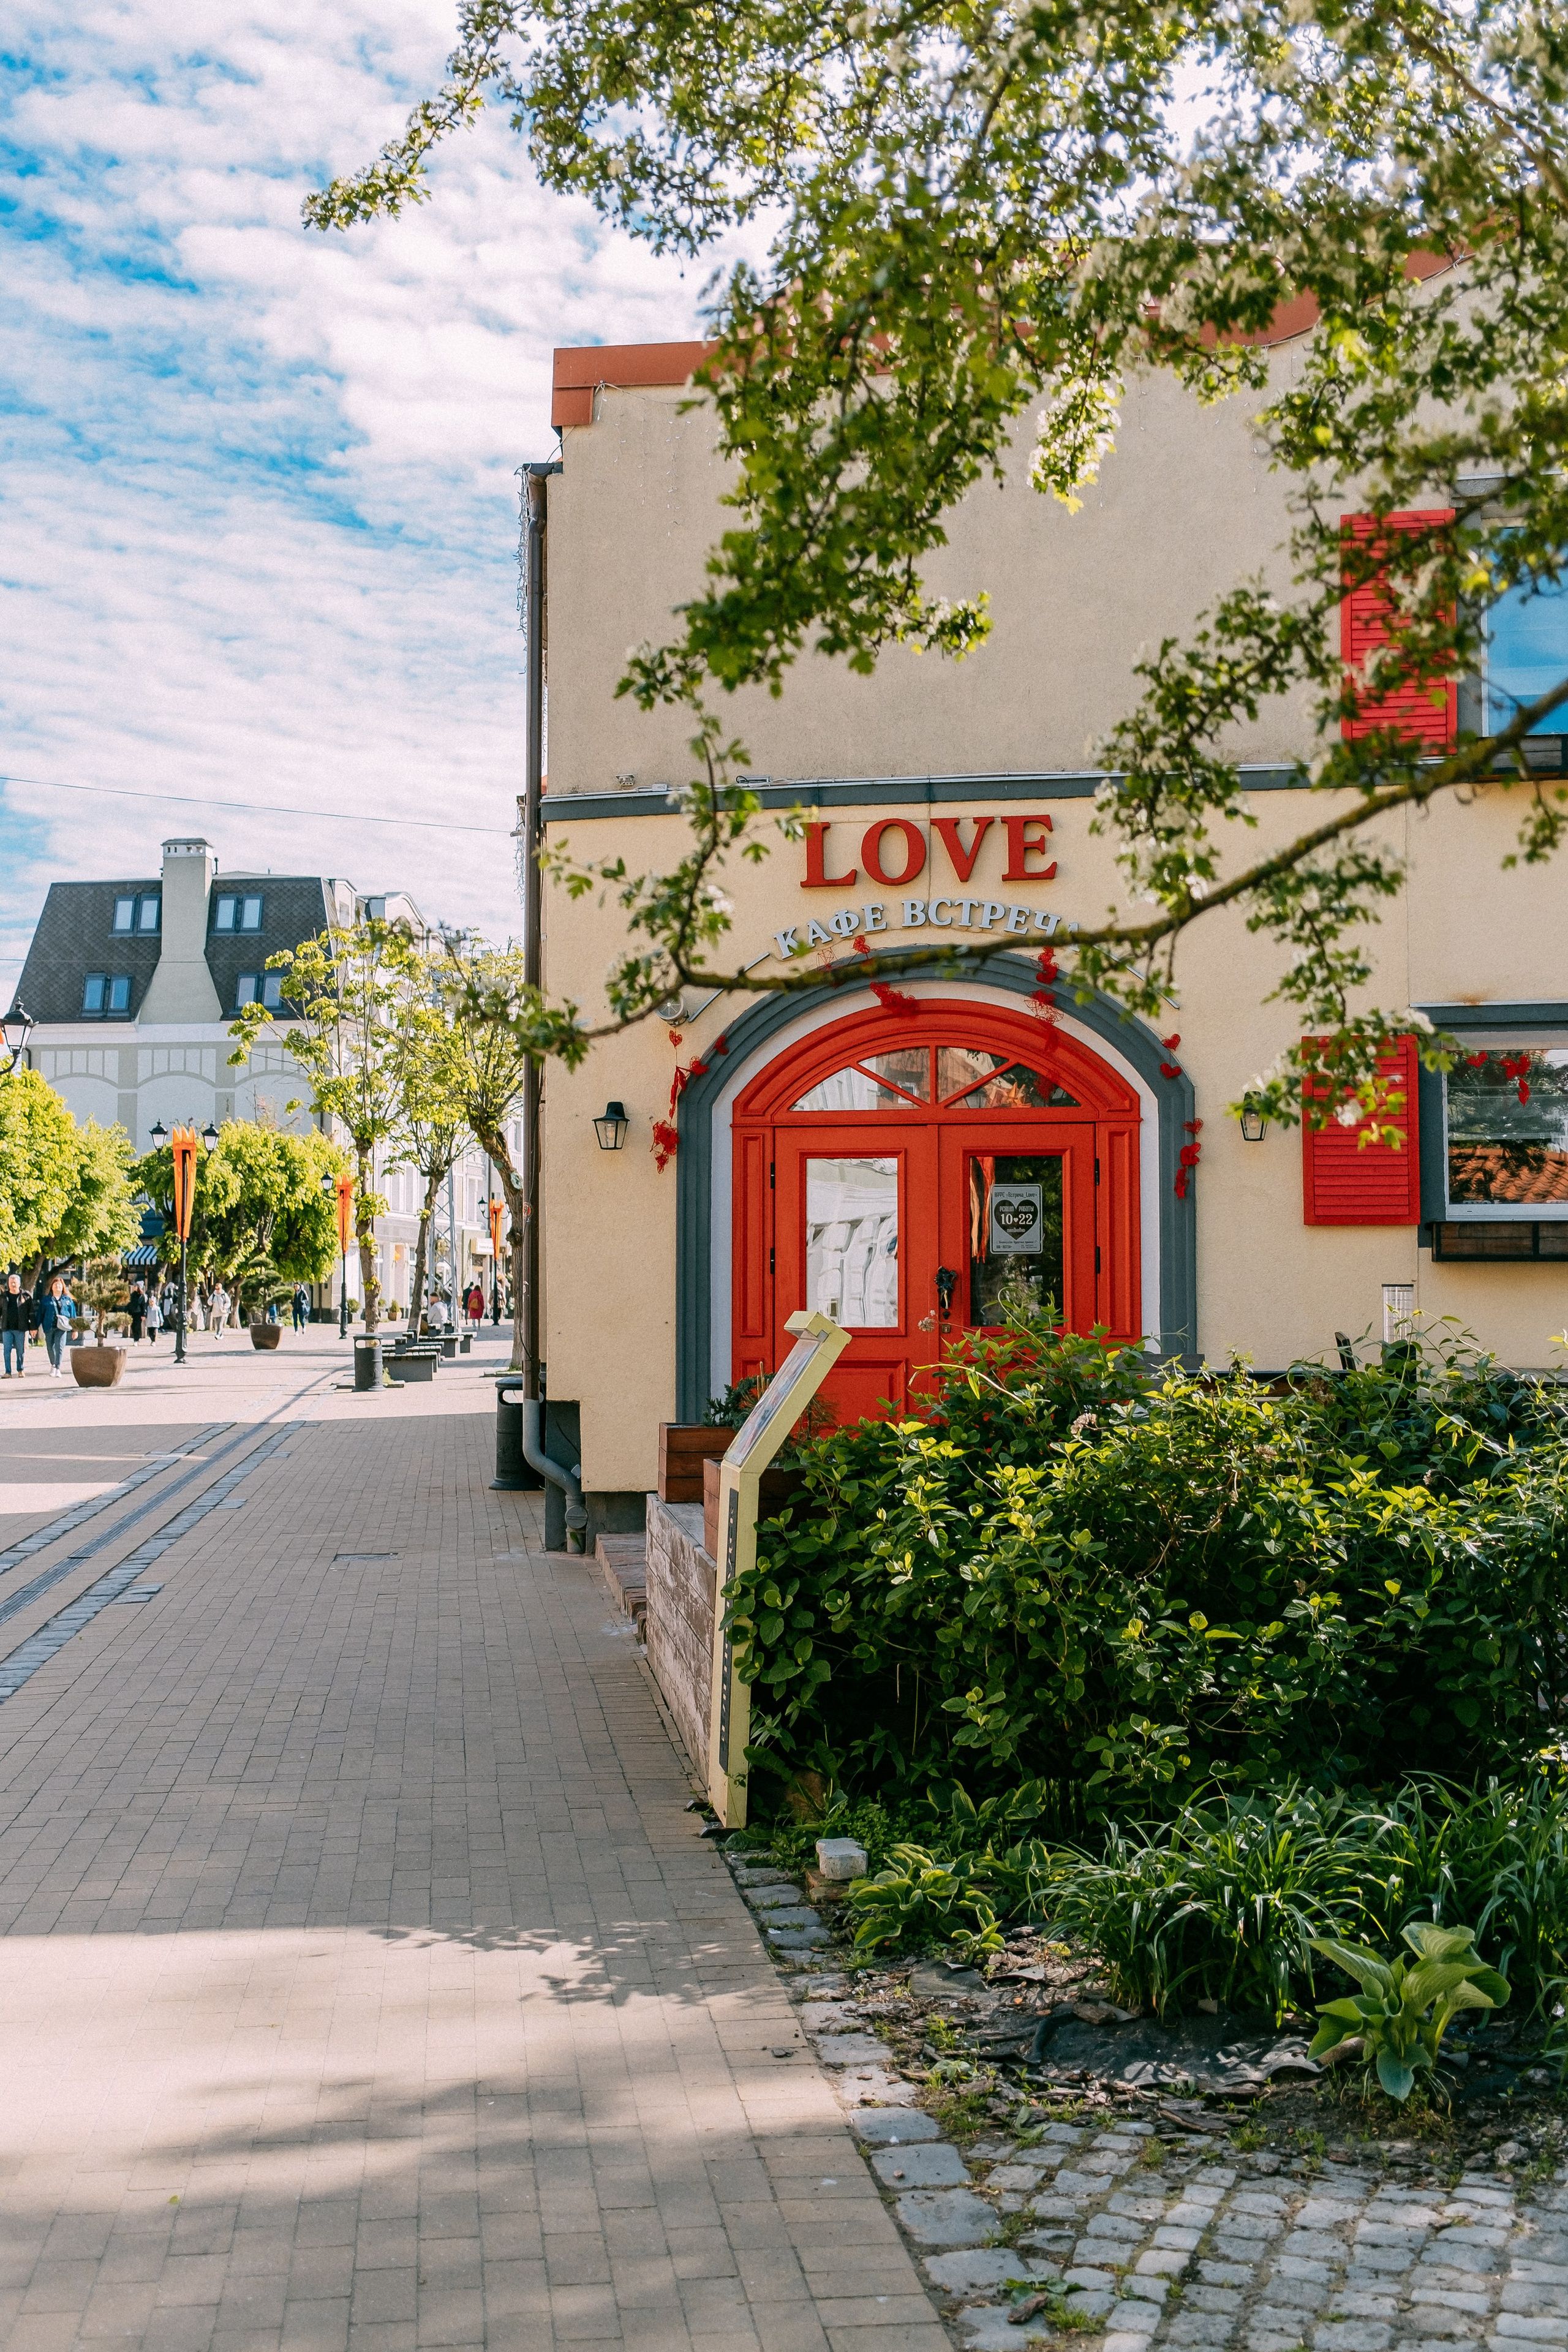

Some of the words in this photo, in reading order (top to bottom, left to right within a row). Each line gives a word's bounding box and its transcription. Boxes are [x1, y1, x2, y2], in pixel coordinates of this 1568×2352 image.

[800, 815, 1058, 888] LOVE
[774, 903, 888, 960] КАФЕ
[1001, 1213, 1013, 1225] 10
[1019, 1213, 1033, 1225] 22
